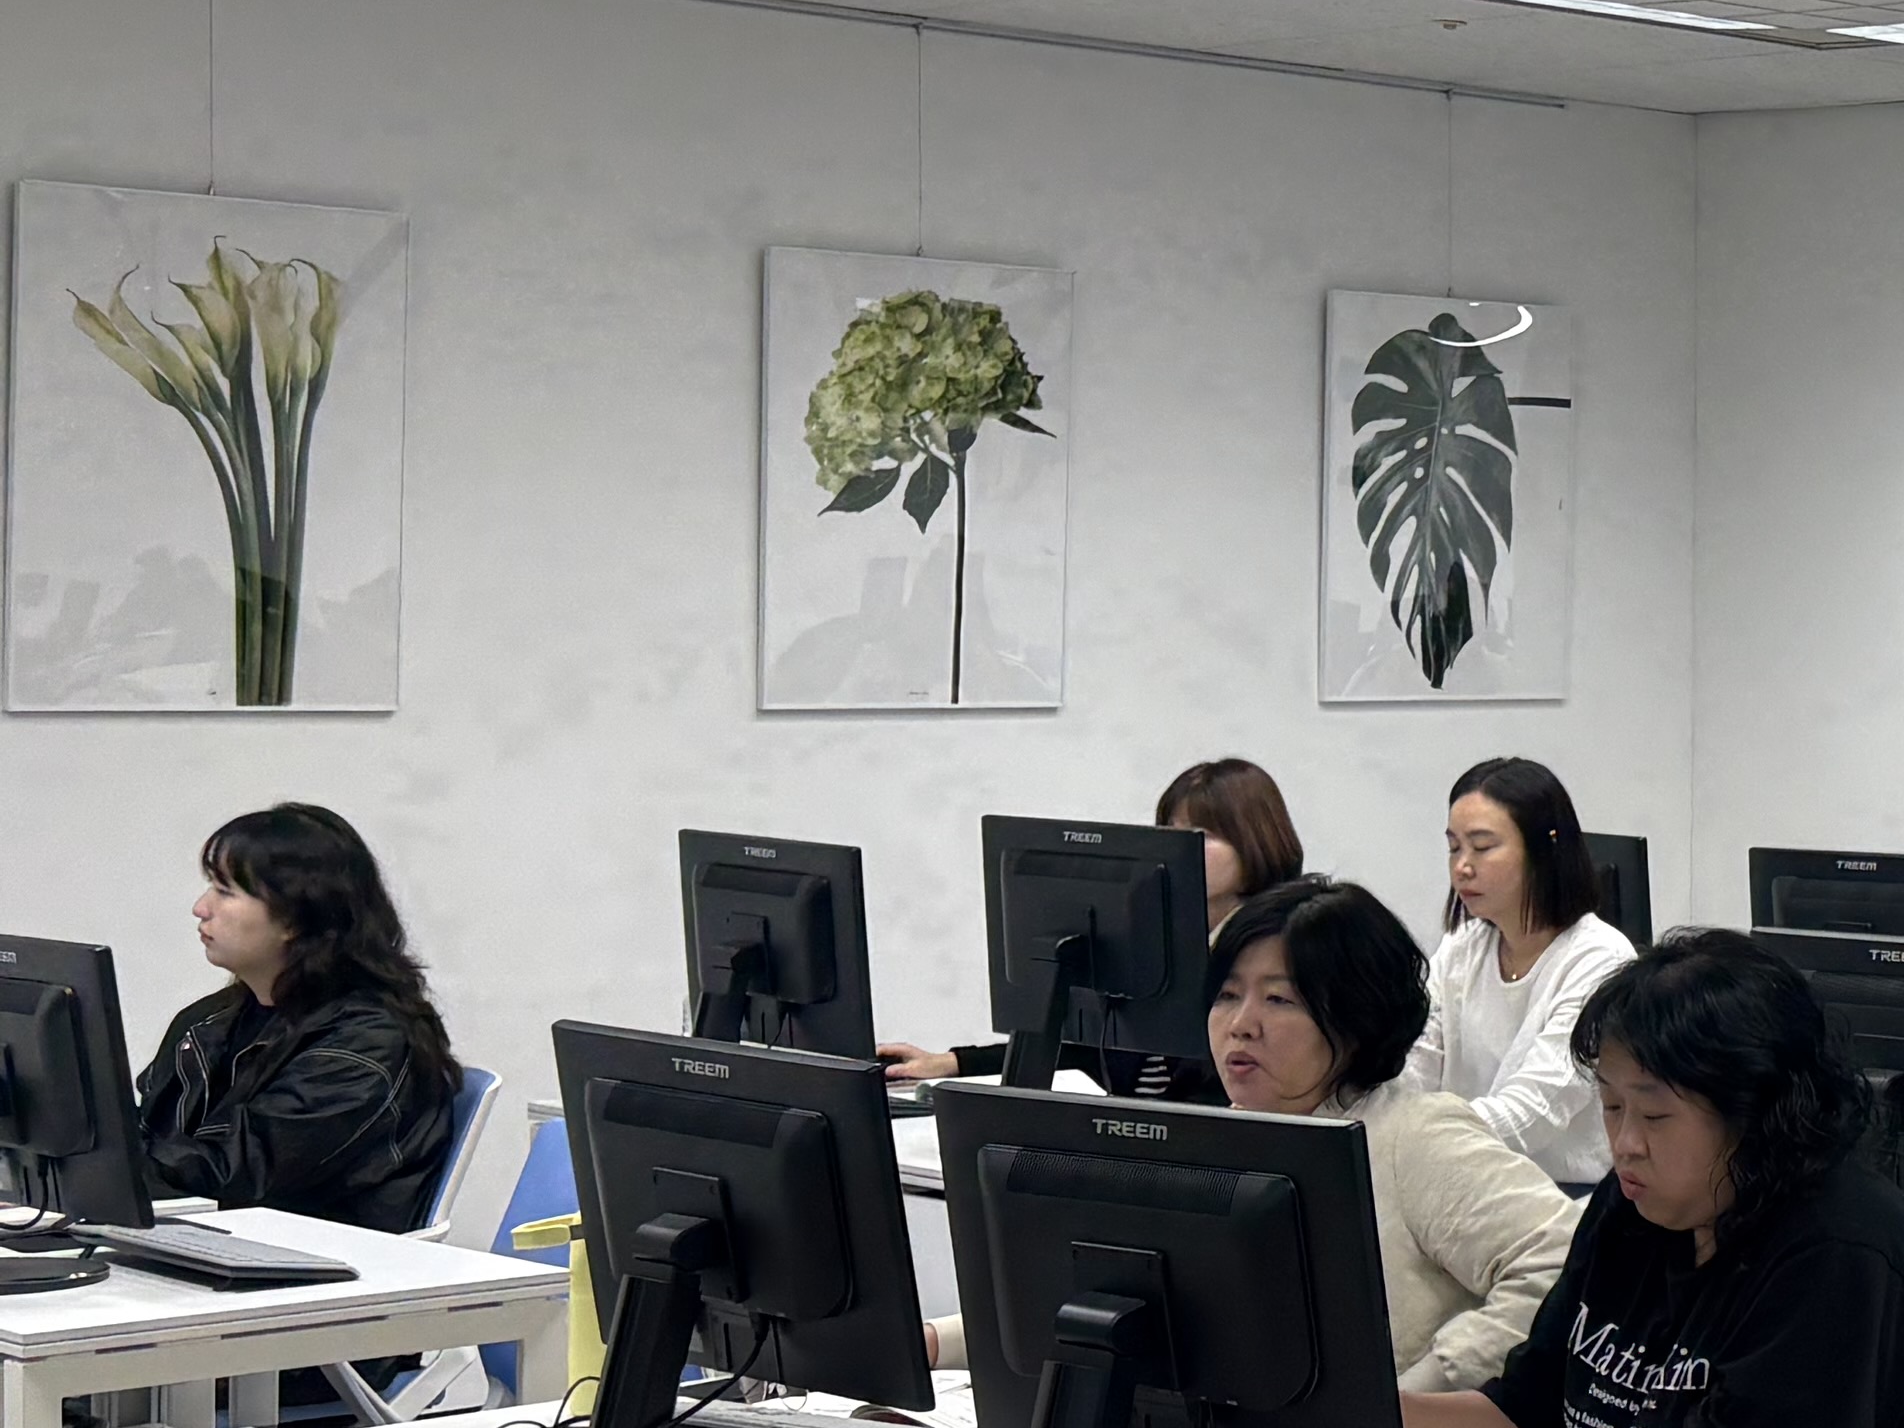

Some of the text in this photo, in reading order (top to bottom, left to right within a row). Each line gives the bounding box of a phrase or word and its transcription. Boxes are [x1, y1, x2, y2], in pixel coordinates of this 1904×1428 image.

[1063, 830, 1101, 843] TREEM
[672, 1058, 729, 1078] TREEM
[1092, 1118, 1168, 1140] TREEM
